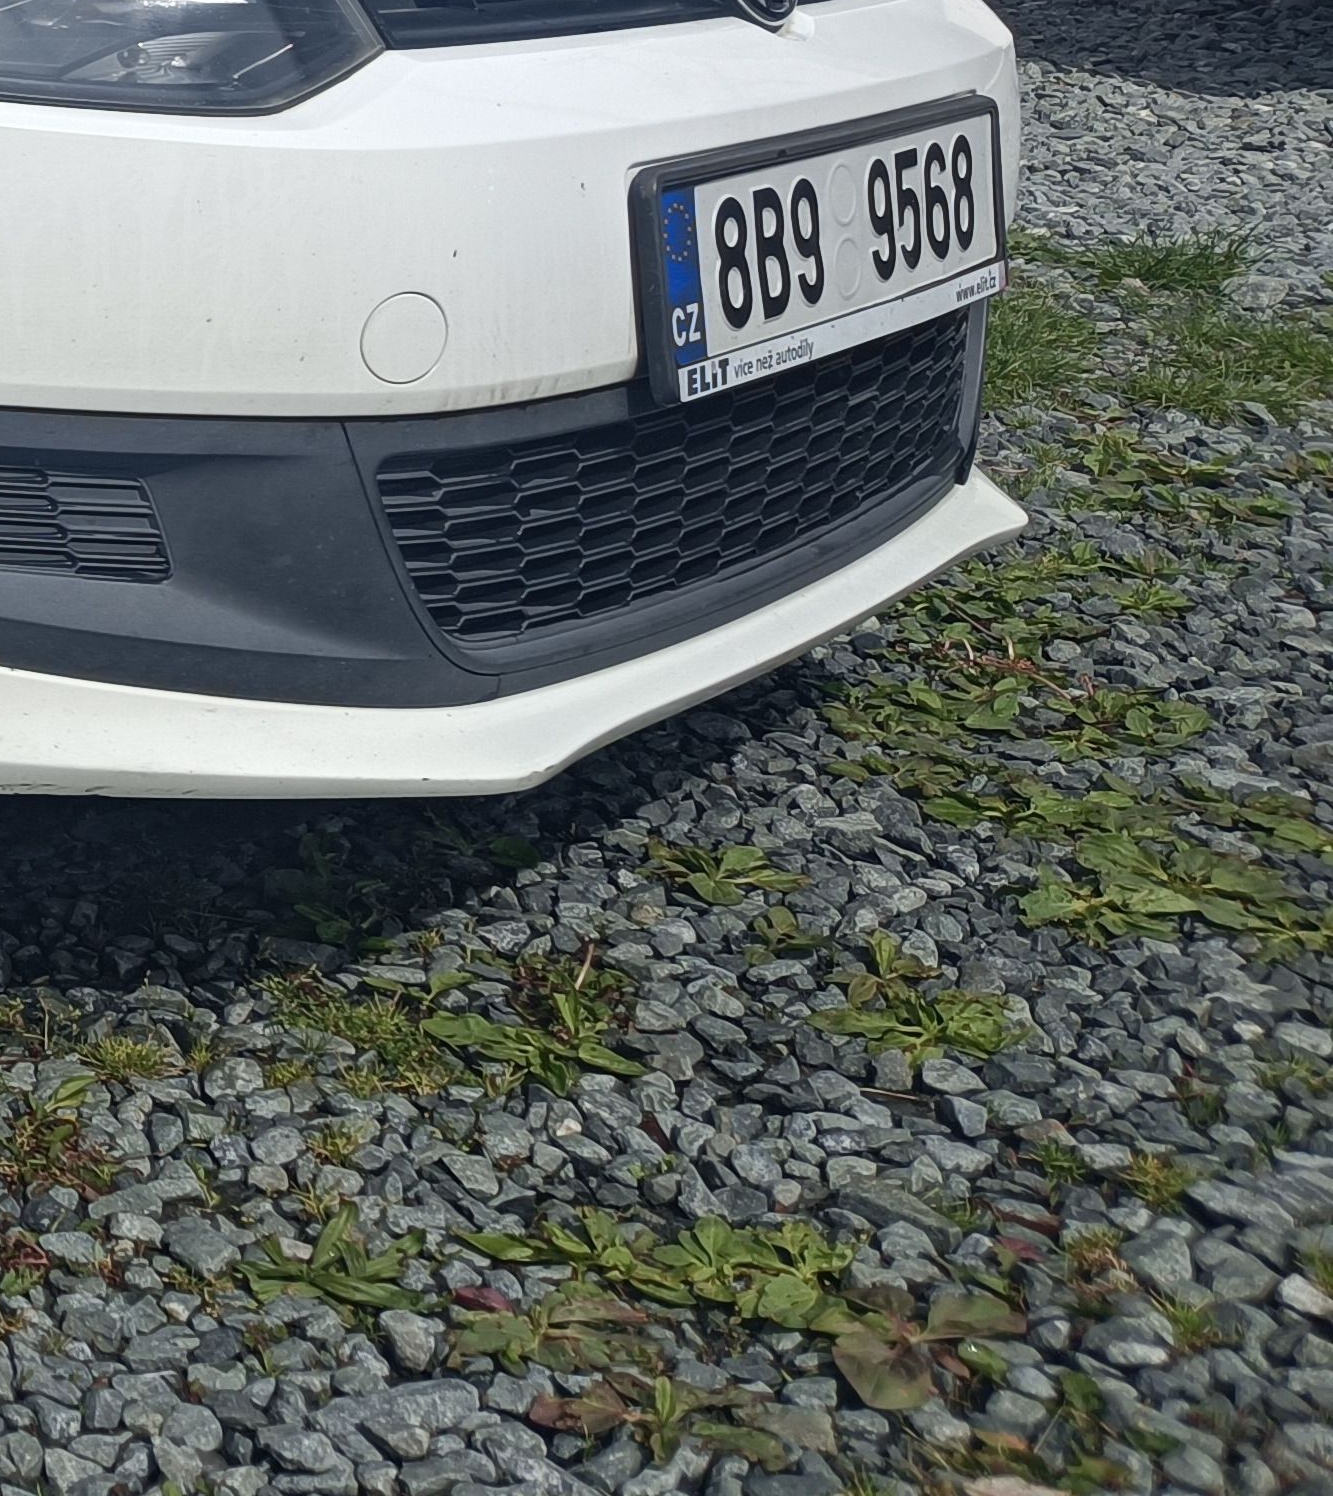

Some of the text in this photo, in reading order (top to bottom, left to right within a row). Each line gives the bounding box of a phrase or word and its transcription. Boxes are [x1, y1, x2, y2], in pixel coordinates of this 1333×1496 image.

[714, 133, 975, 329] 8B9 9568
[956, 275, 996, 302] www.elit.cz
[671, 302, 702, 347] CZ
